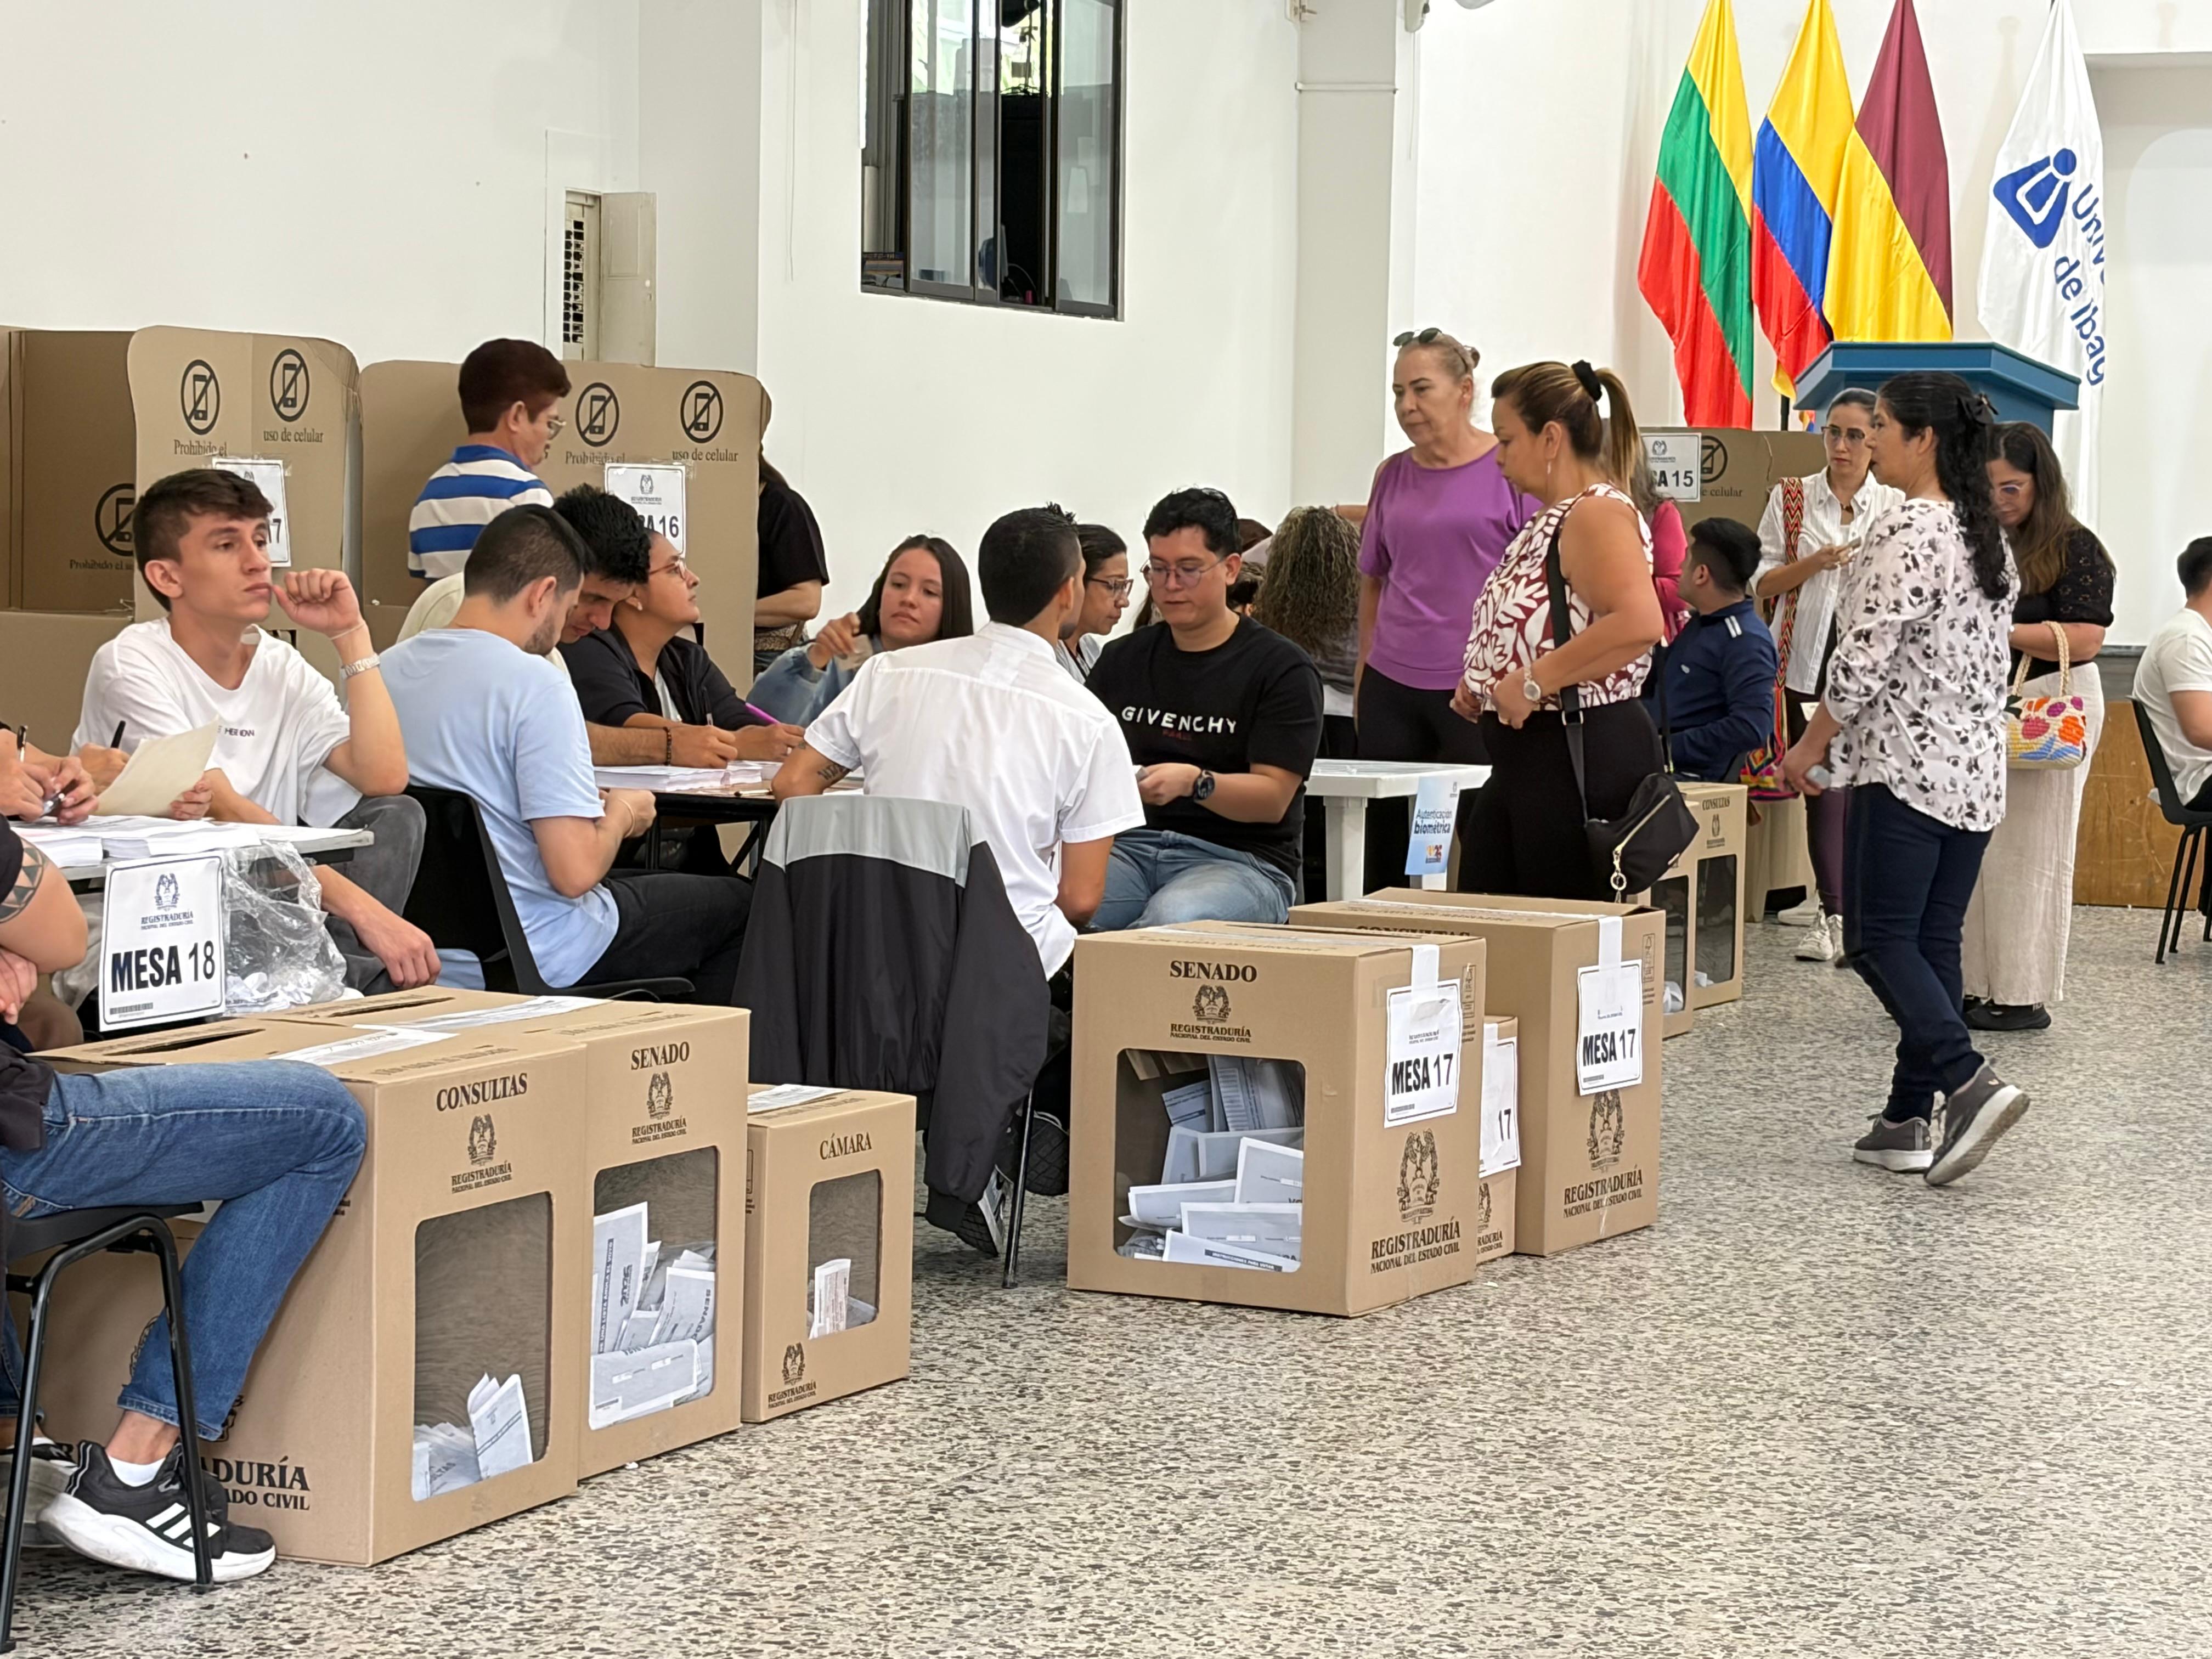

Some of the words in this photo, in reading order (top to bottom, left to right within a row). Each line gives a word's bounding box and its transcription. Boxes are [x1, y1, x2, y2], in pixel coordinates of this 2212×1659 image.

[2072, 184, 2105, 285] Univ
[2055, 256, 2083, 301] de
[174, 439, 217, 455] Prohibido
[219, 442, 227, 456] el
[263, 430, 278, 441] uso
[281, 428, 291, 442] de
[294, 428, 324, 442] celular
[672, 450, 689, 460] uso
[691, 448, 703, 461] de
[705, 449, 738, 462] celular
[1672, 470, 1694, 487] 15
[1709, 487, 1742, 497] celular
[659, 515, 679, 538] 16
[1121, 706, 1237, 734] GIVENCHY
[111, 945, 182, 993] MESA
[189, 940, 215, 982] 18
[1170, 960, 1257, 983] SENADO
[1171, 1023, 1251, 1037] REGISTRADURÍA
[631, 1041, 690, 1070] SENADO
[1583, 1031, 1617, 1066] MESA
[1620, 1028, 1636, 1059] 17
[1392, 1057, 1431, 1096] MESA
[1434, 1053, 1453, 1087] 17
[437, 1073, 528, 1111] CONSULTAS
[632, 1115, 687, 1138] REGISTRADURÍA
[1498, 1108, 1511, 1141] 17
[820, 1132, 872, 1160] CÁMARA
[451, 1160, 512, 1186] REGISTRADURÍA
[1564, 1164, 1643, 1205] REGISTRADURÍA
[1593, 1199, 1604, 1211] DEL
[1371, 1216, 1460, 1260] REGISTRADURÍA
[1477, 1228, 1503, 1246] RADURÍA
[1370, 1255, 1403, 1274] NACIONAL
[1404, 1252, 1417, 1266] DEL
[1418, 1245, 1443, 1262] ESTADO
[1443, 1242, 1460, 1256] CIVIL
[201, 1455, 311, 1491] DURÍA
[263, 1492, 311, 1511] CIVIL
